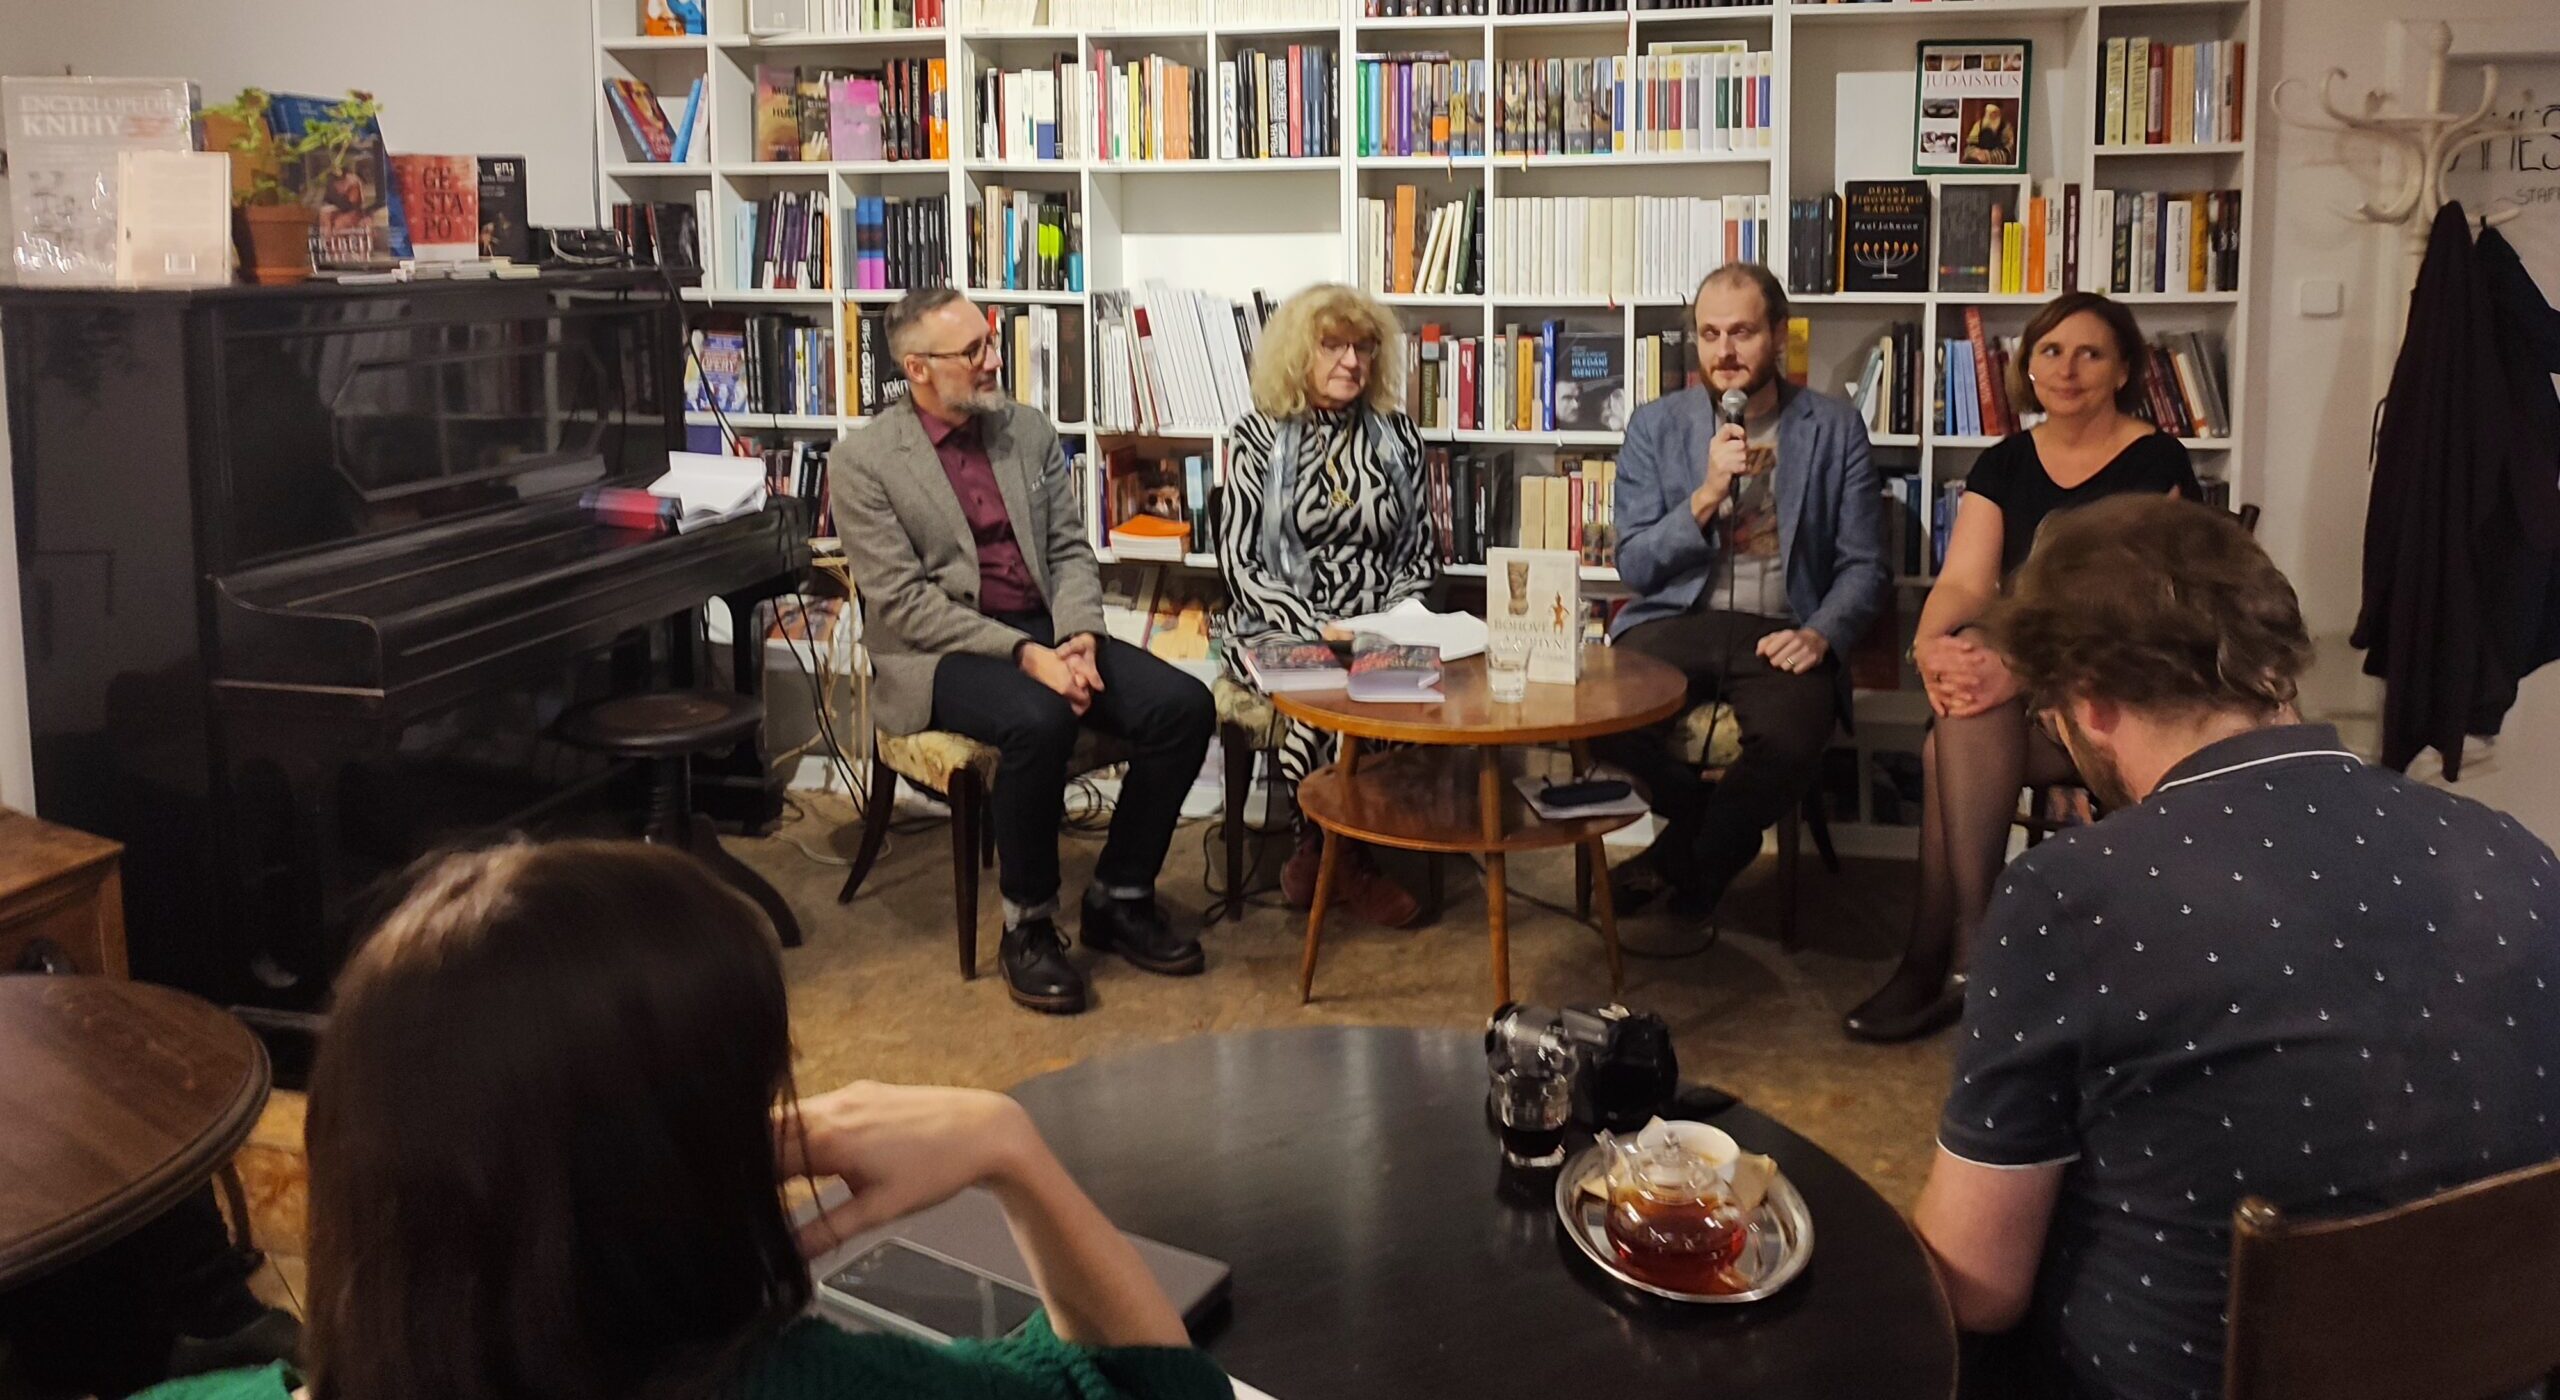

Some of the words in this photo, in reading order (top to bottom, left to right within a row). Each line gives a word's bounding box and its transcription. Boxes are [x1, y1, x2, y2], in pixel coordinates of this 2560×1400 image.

[1925, 74, 2020, 88] JUDAISMUS
[23, 114, 123, 136] KNIHY
[423, 166, 450, 190] GE
[424, 193, 464, 215] STA
[424, 221, 452, 240] PO
[1855, 221, 1876, 230] Paul
[1879, 221, 1919, 230] Johnson
[1571, 368, 1608, 378] IDENTITY
